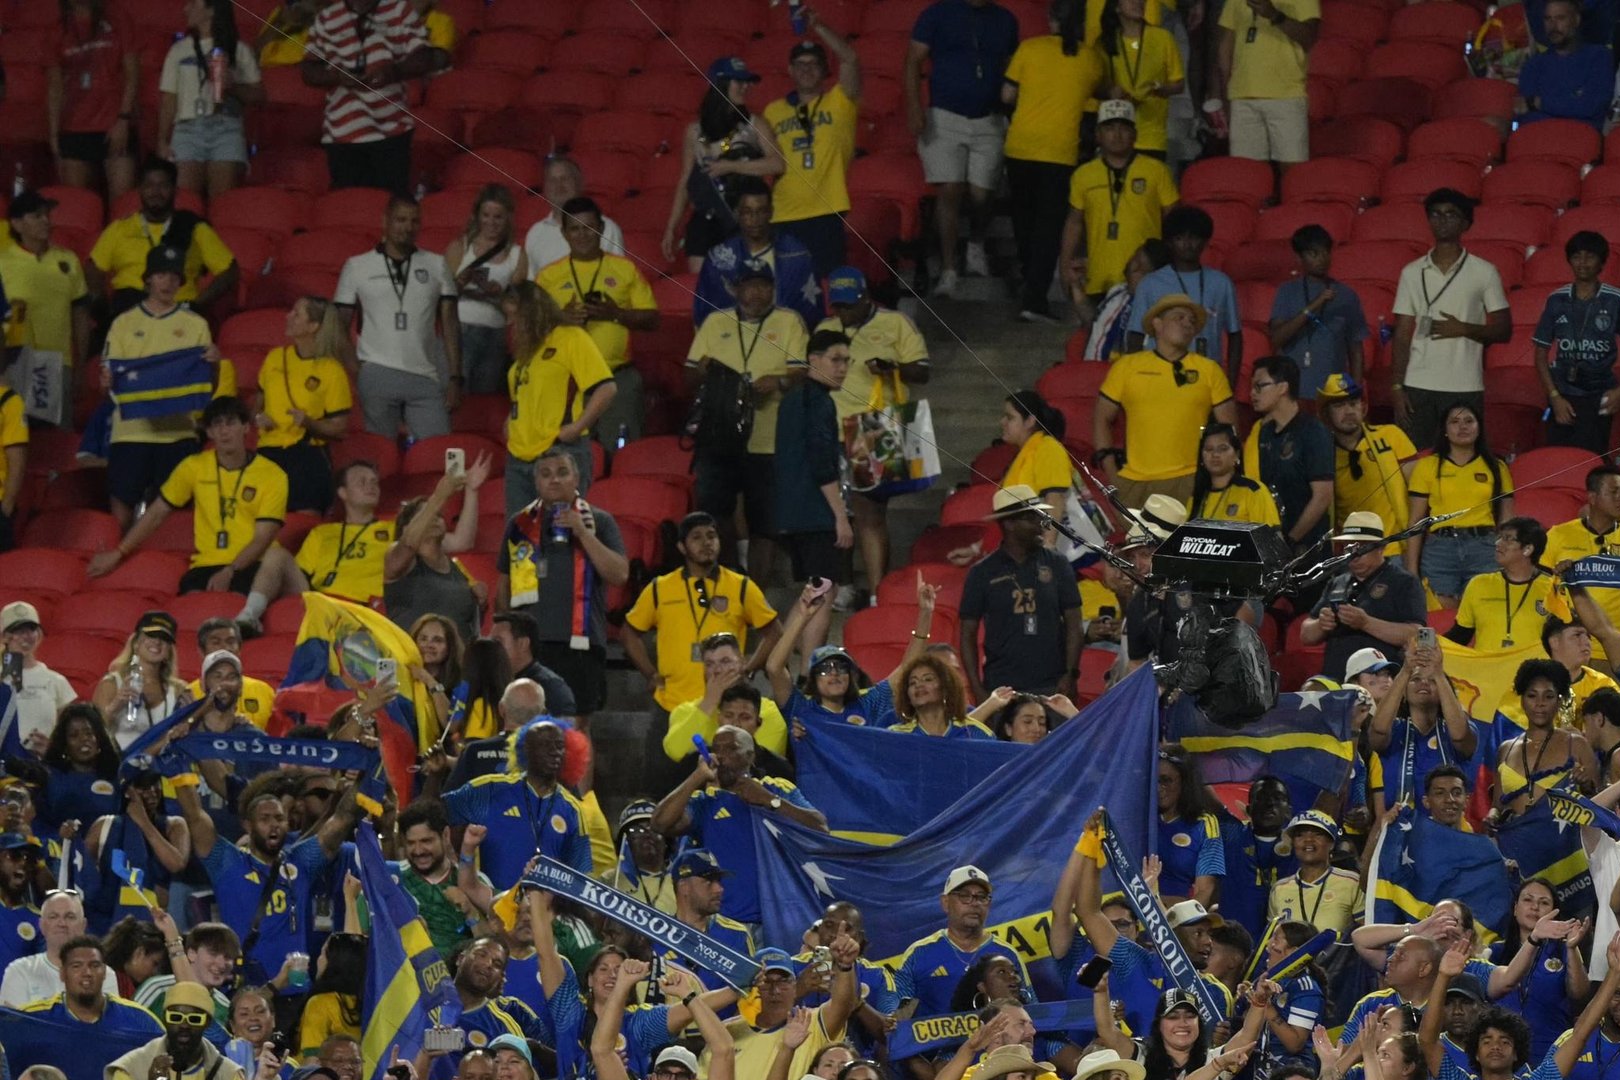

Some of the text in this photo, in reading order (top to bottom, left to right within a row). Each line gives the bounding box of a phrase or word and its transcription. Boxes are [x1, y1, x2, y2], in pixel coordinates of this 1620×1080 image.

[1179, 541, 1236, 557] WILDCAT
[1182, 537, 1216, 545] SKYCAM
[1592, 562, 1616, 573] BLOU
[1012, 588, 1037, 614] 23
[213, 738, 339, 764] Curaçao
[697, 942, 718, 962] NOS
[717, 951, 737, 971] TEI
